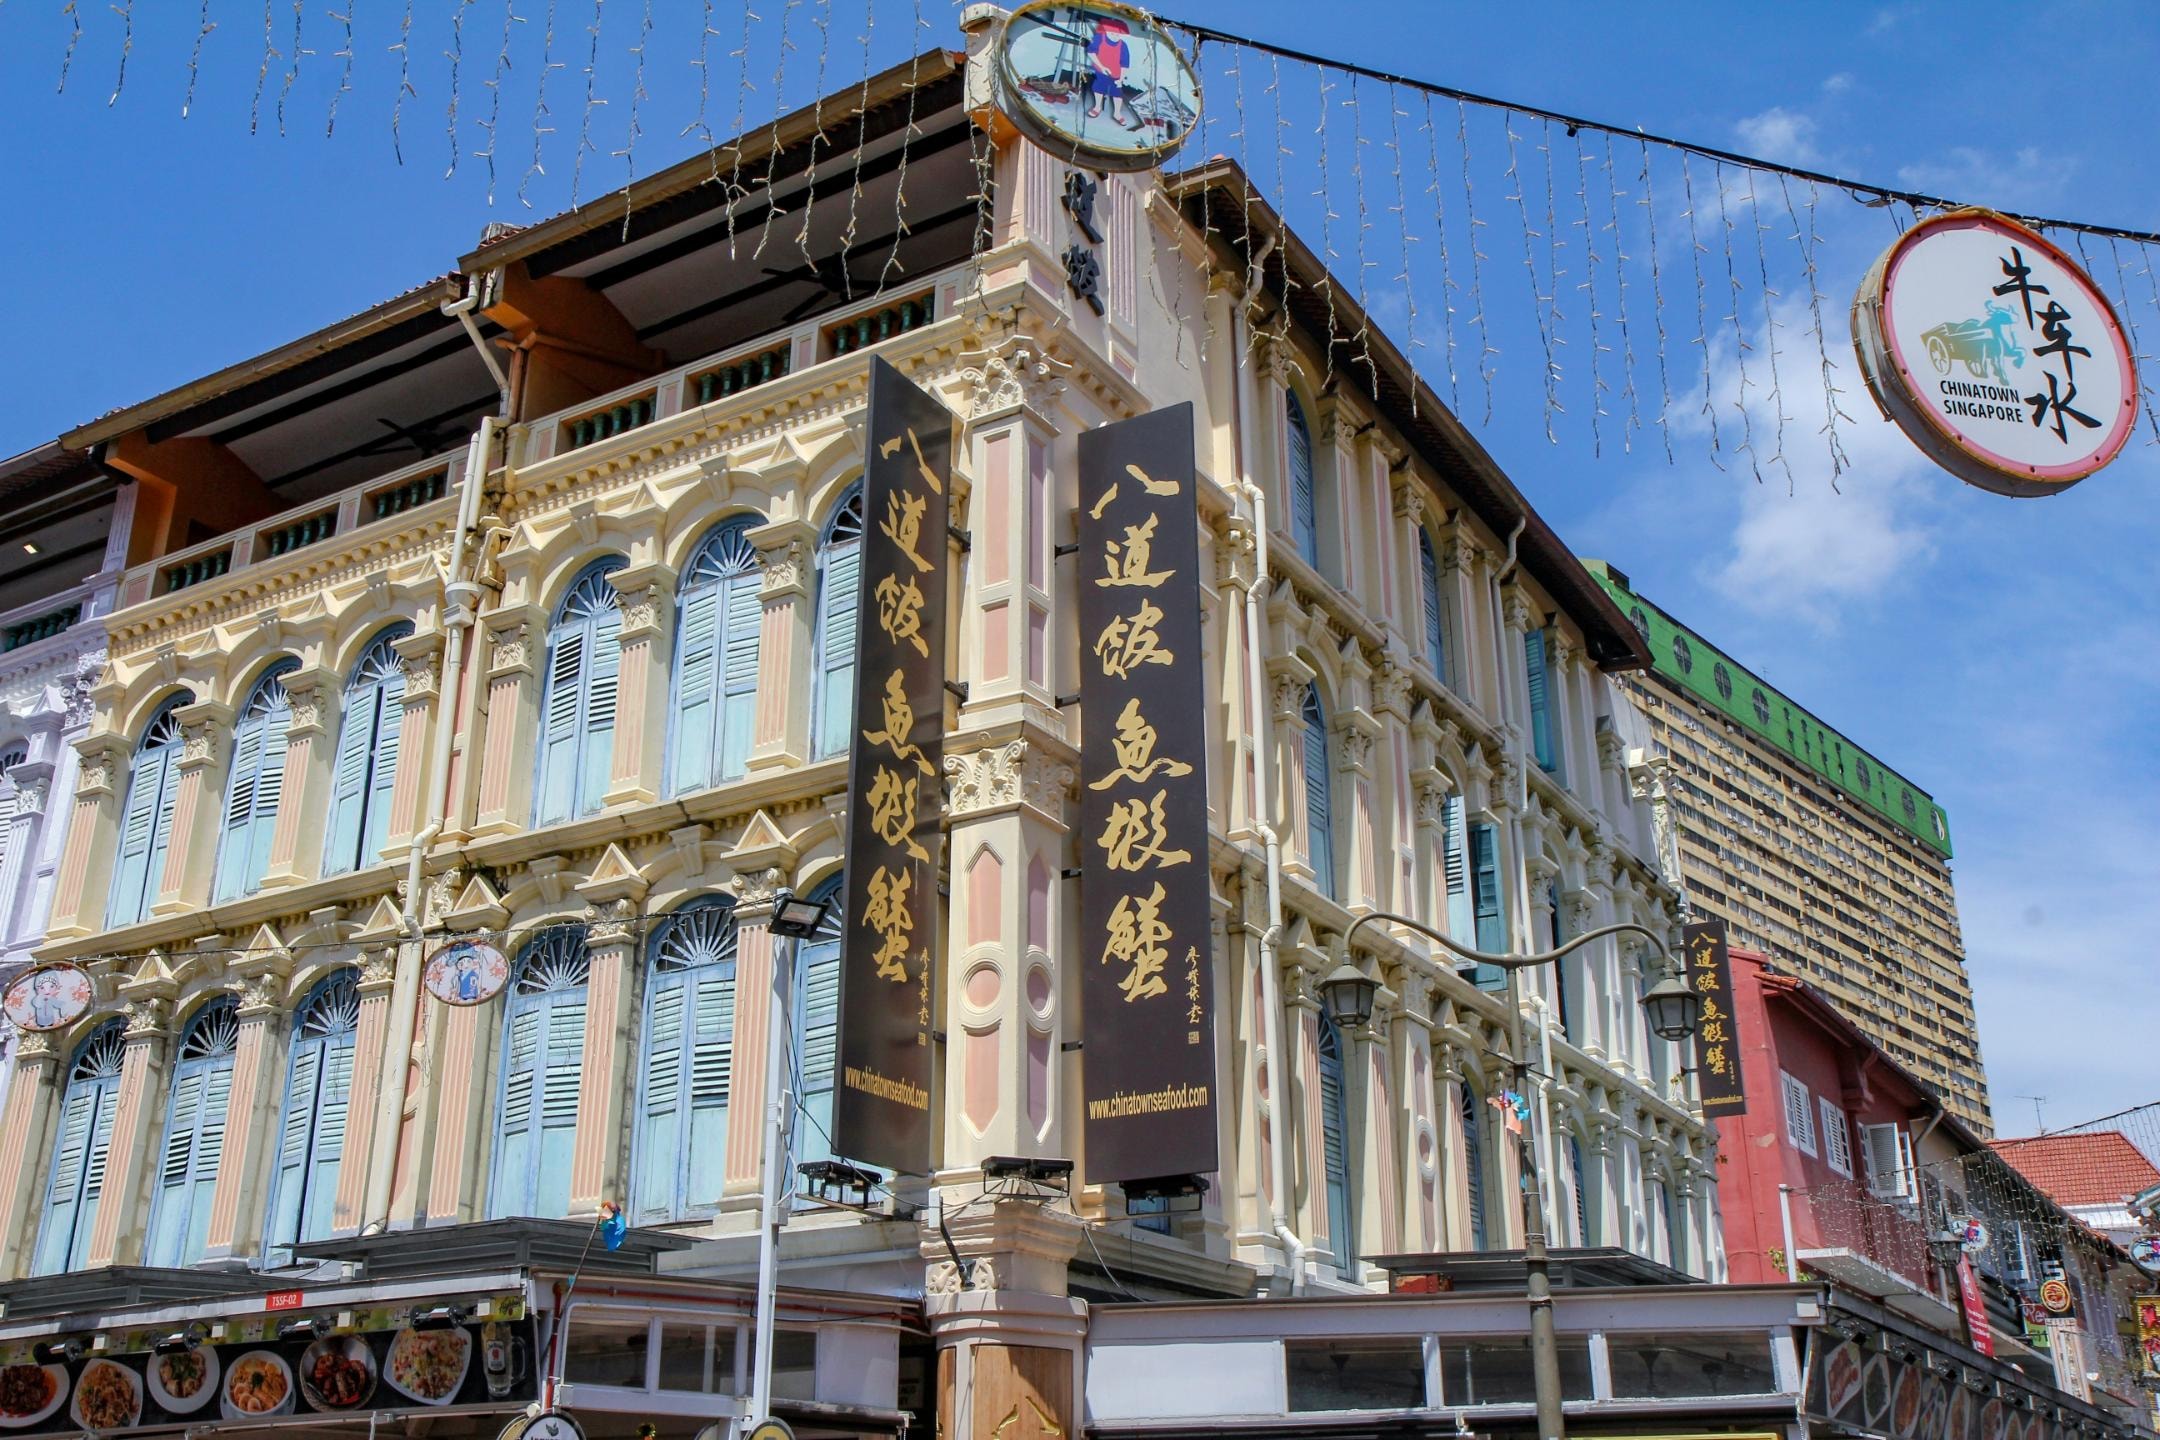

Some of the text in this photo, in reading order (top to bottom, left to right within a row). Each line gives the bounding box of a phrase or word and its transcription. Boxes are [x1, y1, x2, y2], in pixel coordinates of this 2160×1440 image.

[1992, 246, 2102, 445] 牛车水
[1940, 380, 2020, 404] CHINATOWN
[1943, 399, 2024, 423] SINGAPORE
[845, 1065, 929, 1111] www.chinatownseafood.com
[1088, 1083, 1208, 1120] www.chinatownseafood.com
[272, 1294, 297, 1307] TSSF-02
